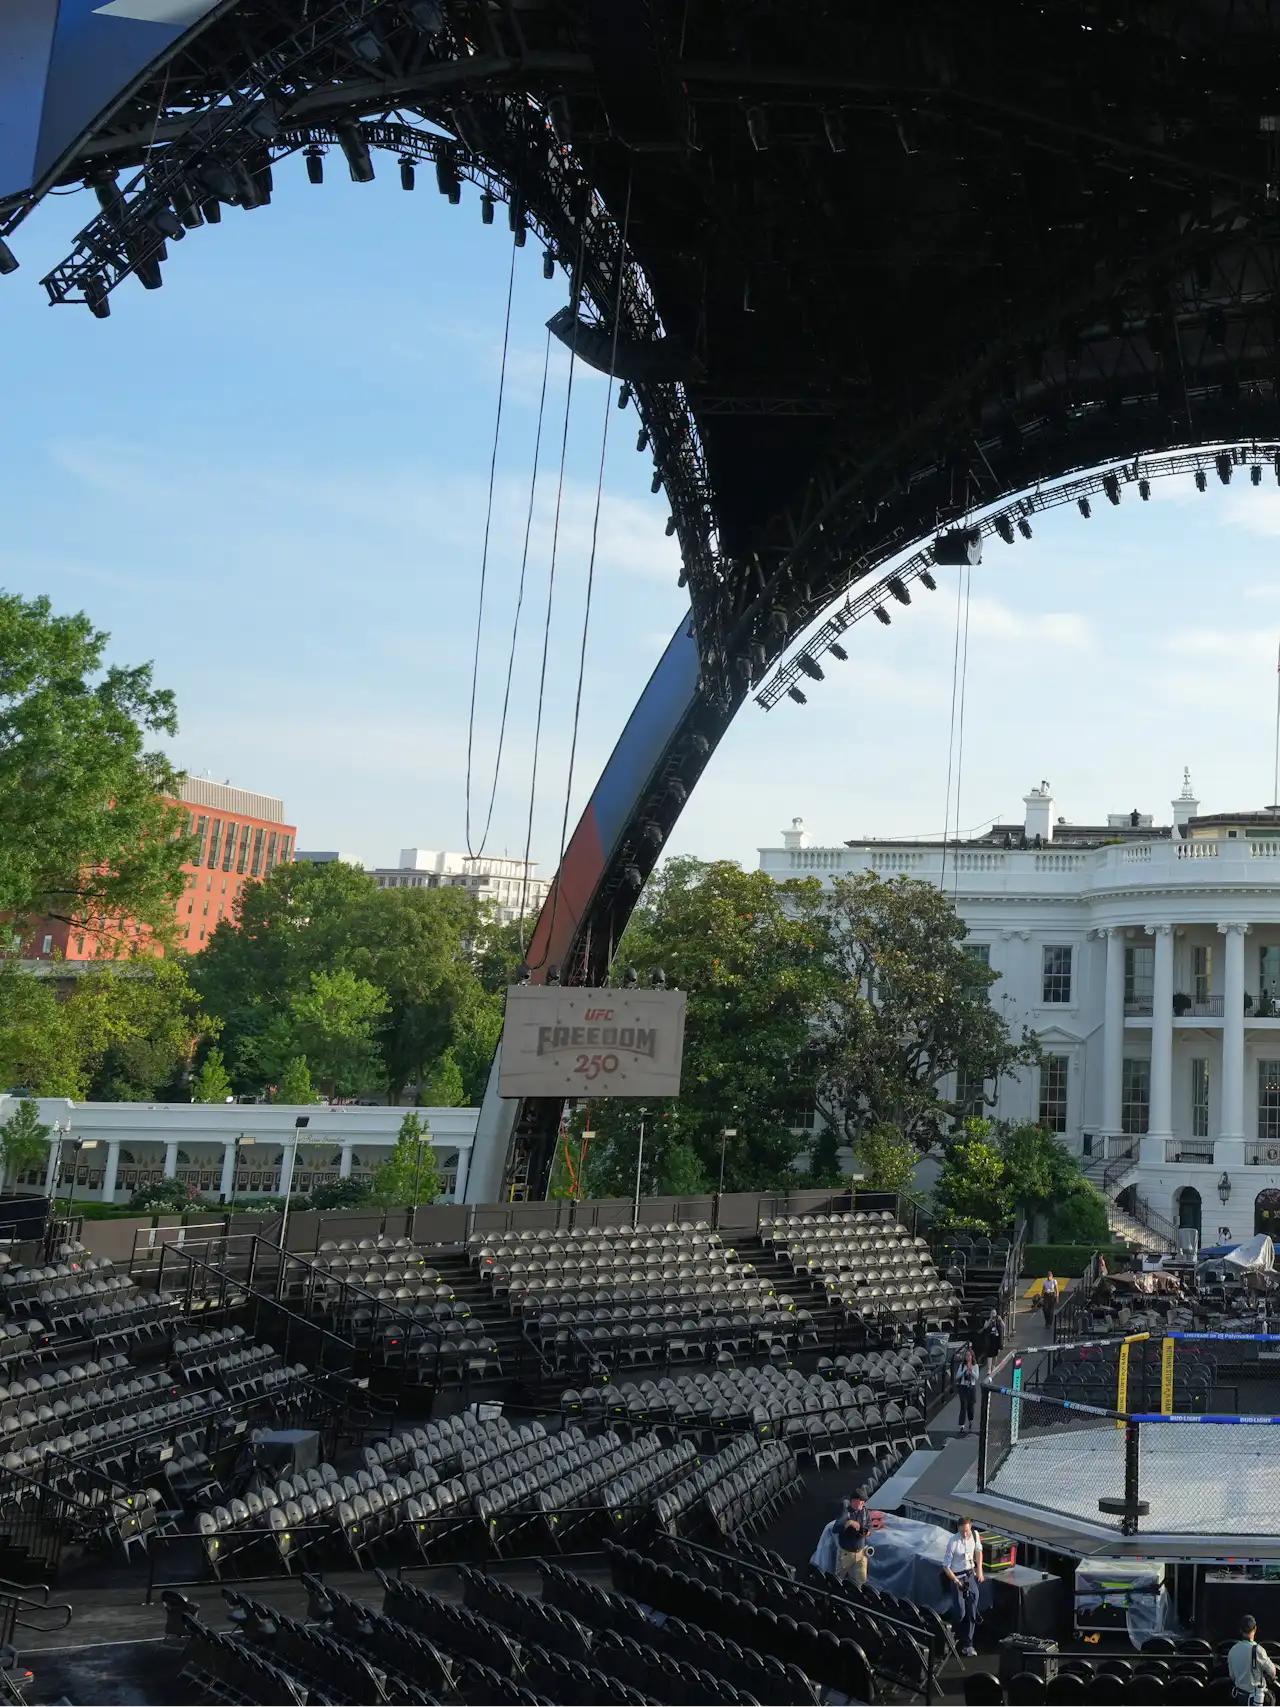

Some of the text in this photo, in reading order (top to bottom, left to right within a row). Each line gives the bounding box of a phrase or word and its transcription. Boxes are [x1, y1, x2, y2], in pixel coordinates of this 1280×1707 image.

[584, 1008, 615, 1022] UFC
[536, 1026, 658, 1058] FREEDOM
[573, 1054, 620, 1081] 250
